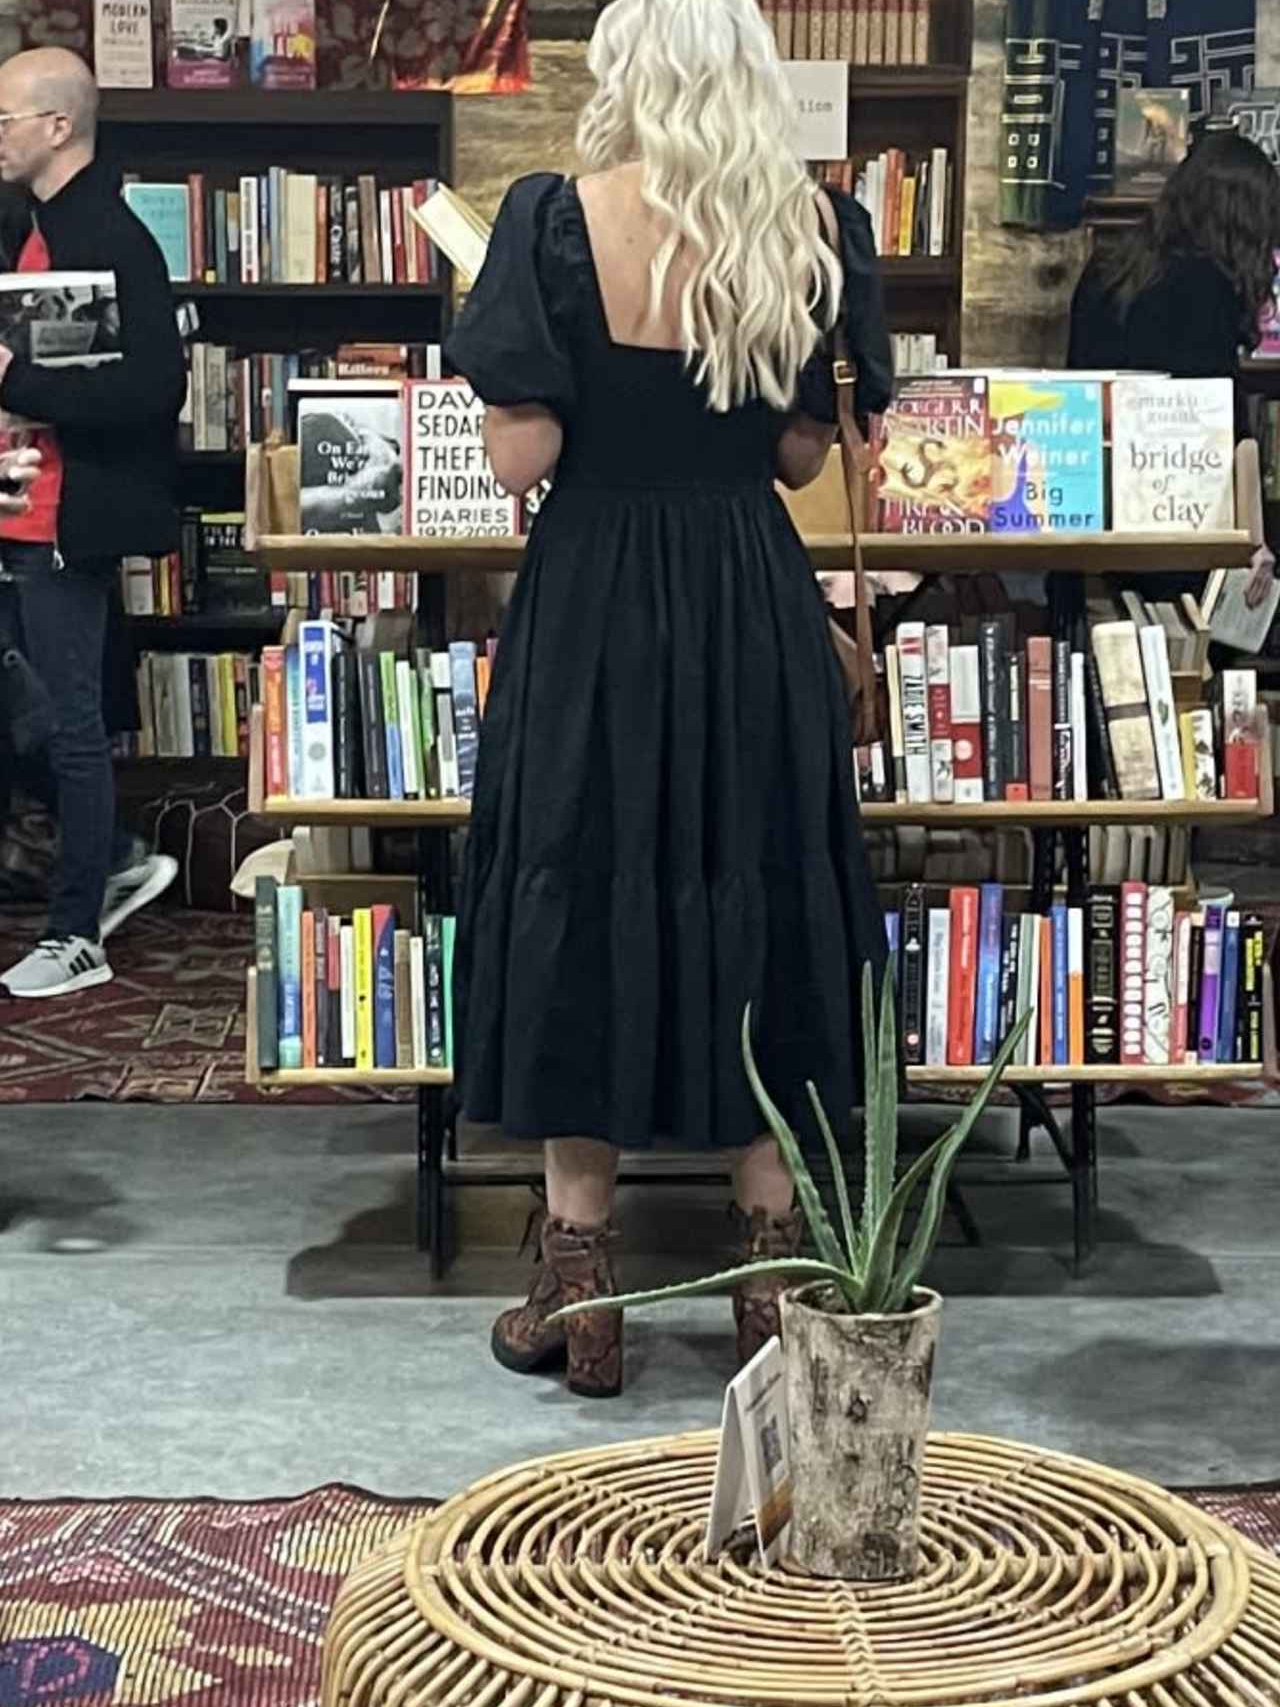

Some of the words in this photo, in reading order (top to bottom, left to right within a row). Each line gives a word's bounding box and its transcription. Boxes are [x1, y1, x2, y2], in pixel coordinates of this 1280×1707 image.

[417, 390, 476, 410] DAV
[417, 413, 483, 437] SEDA
[990, 411, 1095, 437] Jennifer
[317, 440, 341, 455] On
[417, 445, 488, 471] THEFT
[997, 442, 1089, 467] Weiner
[1130, 440, 1224, 475] bridge
[1025, 480, 1064, 507] Big
[1151, 473, 1177, 496] of
[416, 507, 509, 525] DIARIES
[993, 505, 1095, 529] Summer
[1151, 493, 1211, 531] clay
[903, 674, 925, 709] ZADIE
[905, 713, 928, 757] SMITH
